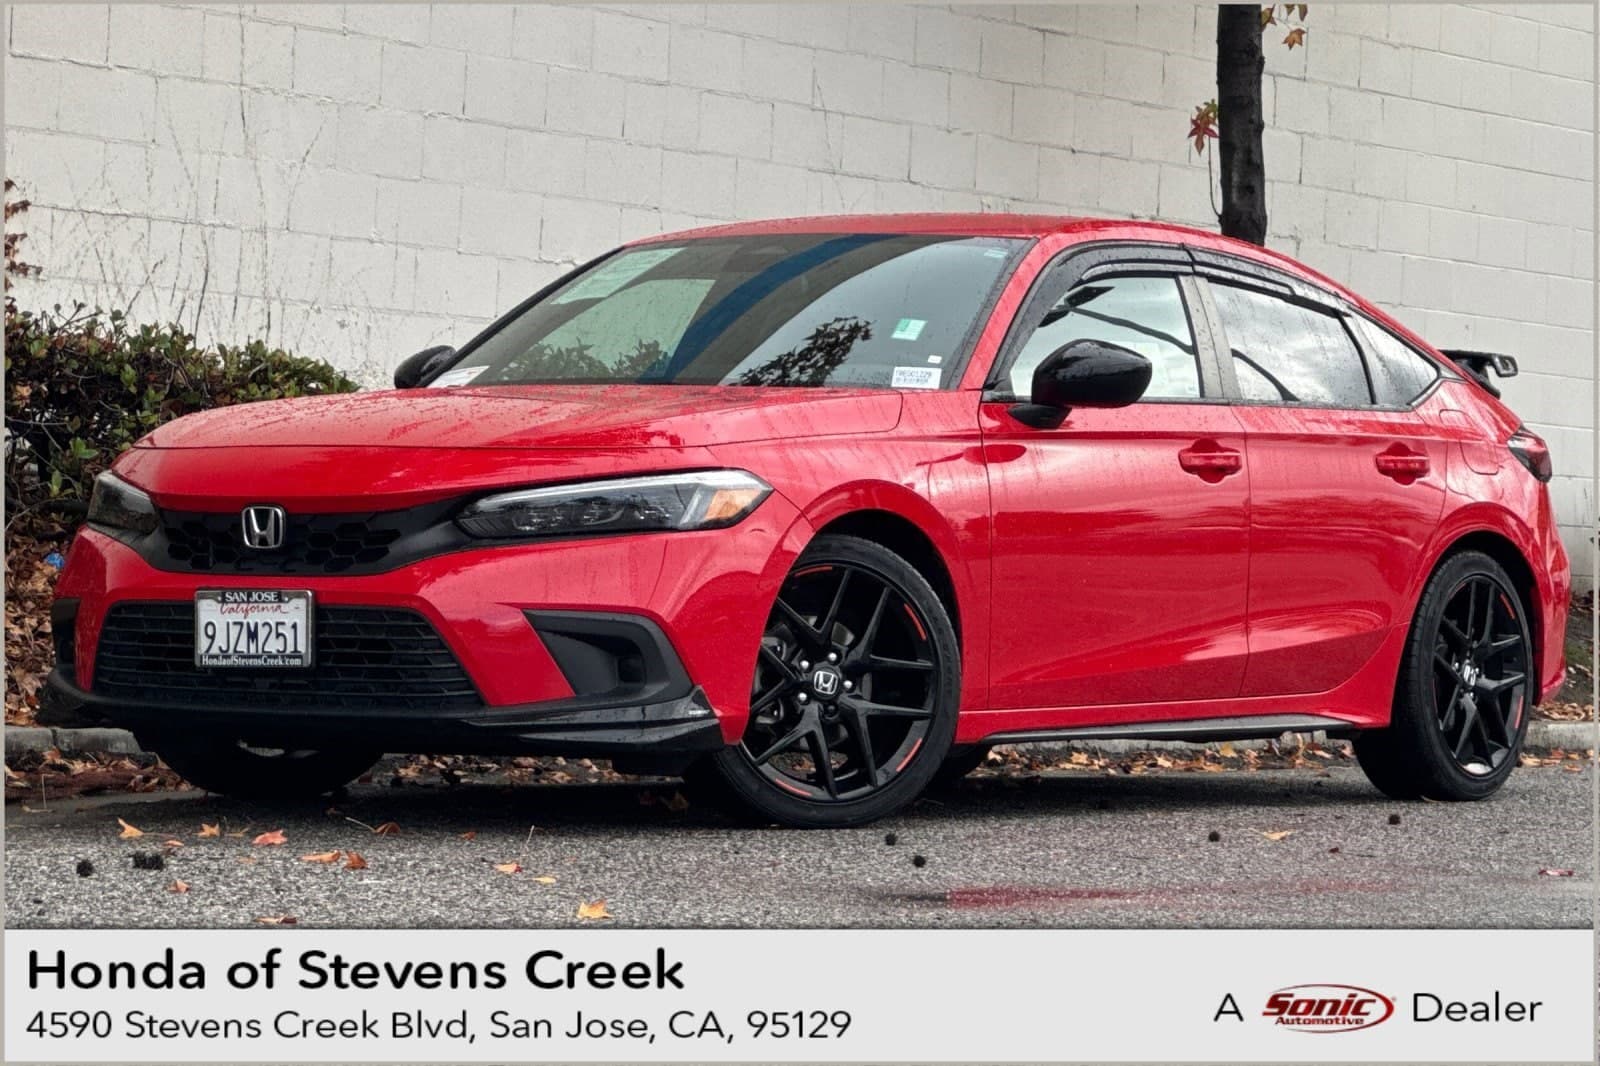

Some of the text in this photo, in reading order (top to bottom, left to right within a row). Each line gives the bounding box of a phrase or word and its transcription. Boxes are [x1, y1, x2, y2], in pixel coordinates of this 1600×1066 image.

[225, 592, 279, 602] SAN JOSE
[220, 602, 289, 619] California
[204, 621, 302, 654] 9JZM251
[202, 655, 302, 666] HondaofStevensCreek.com
